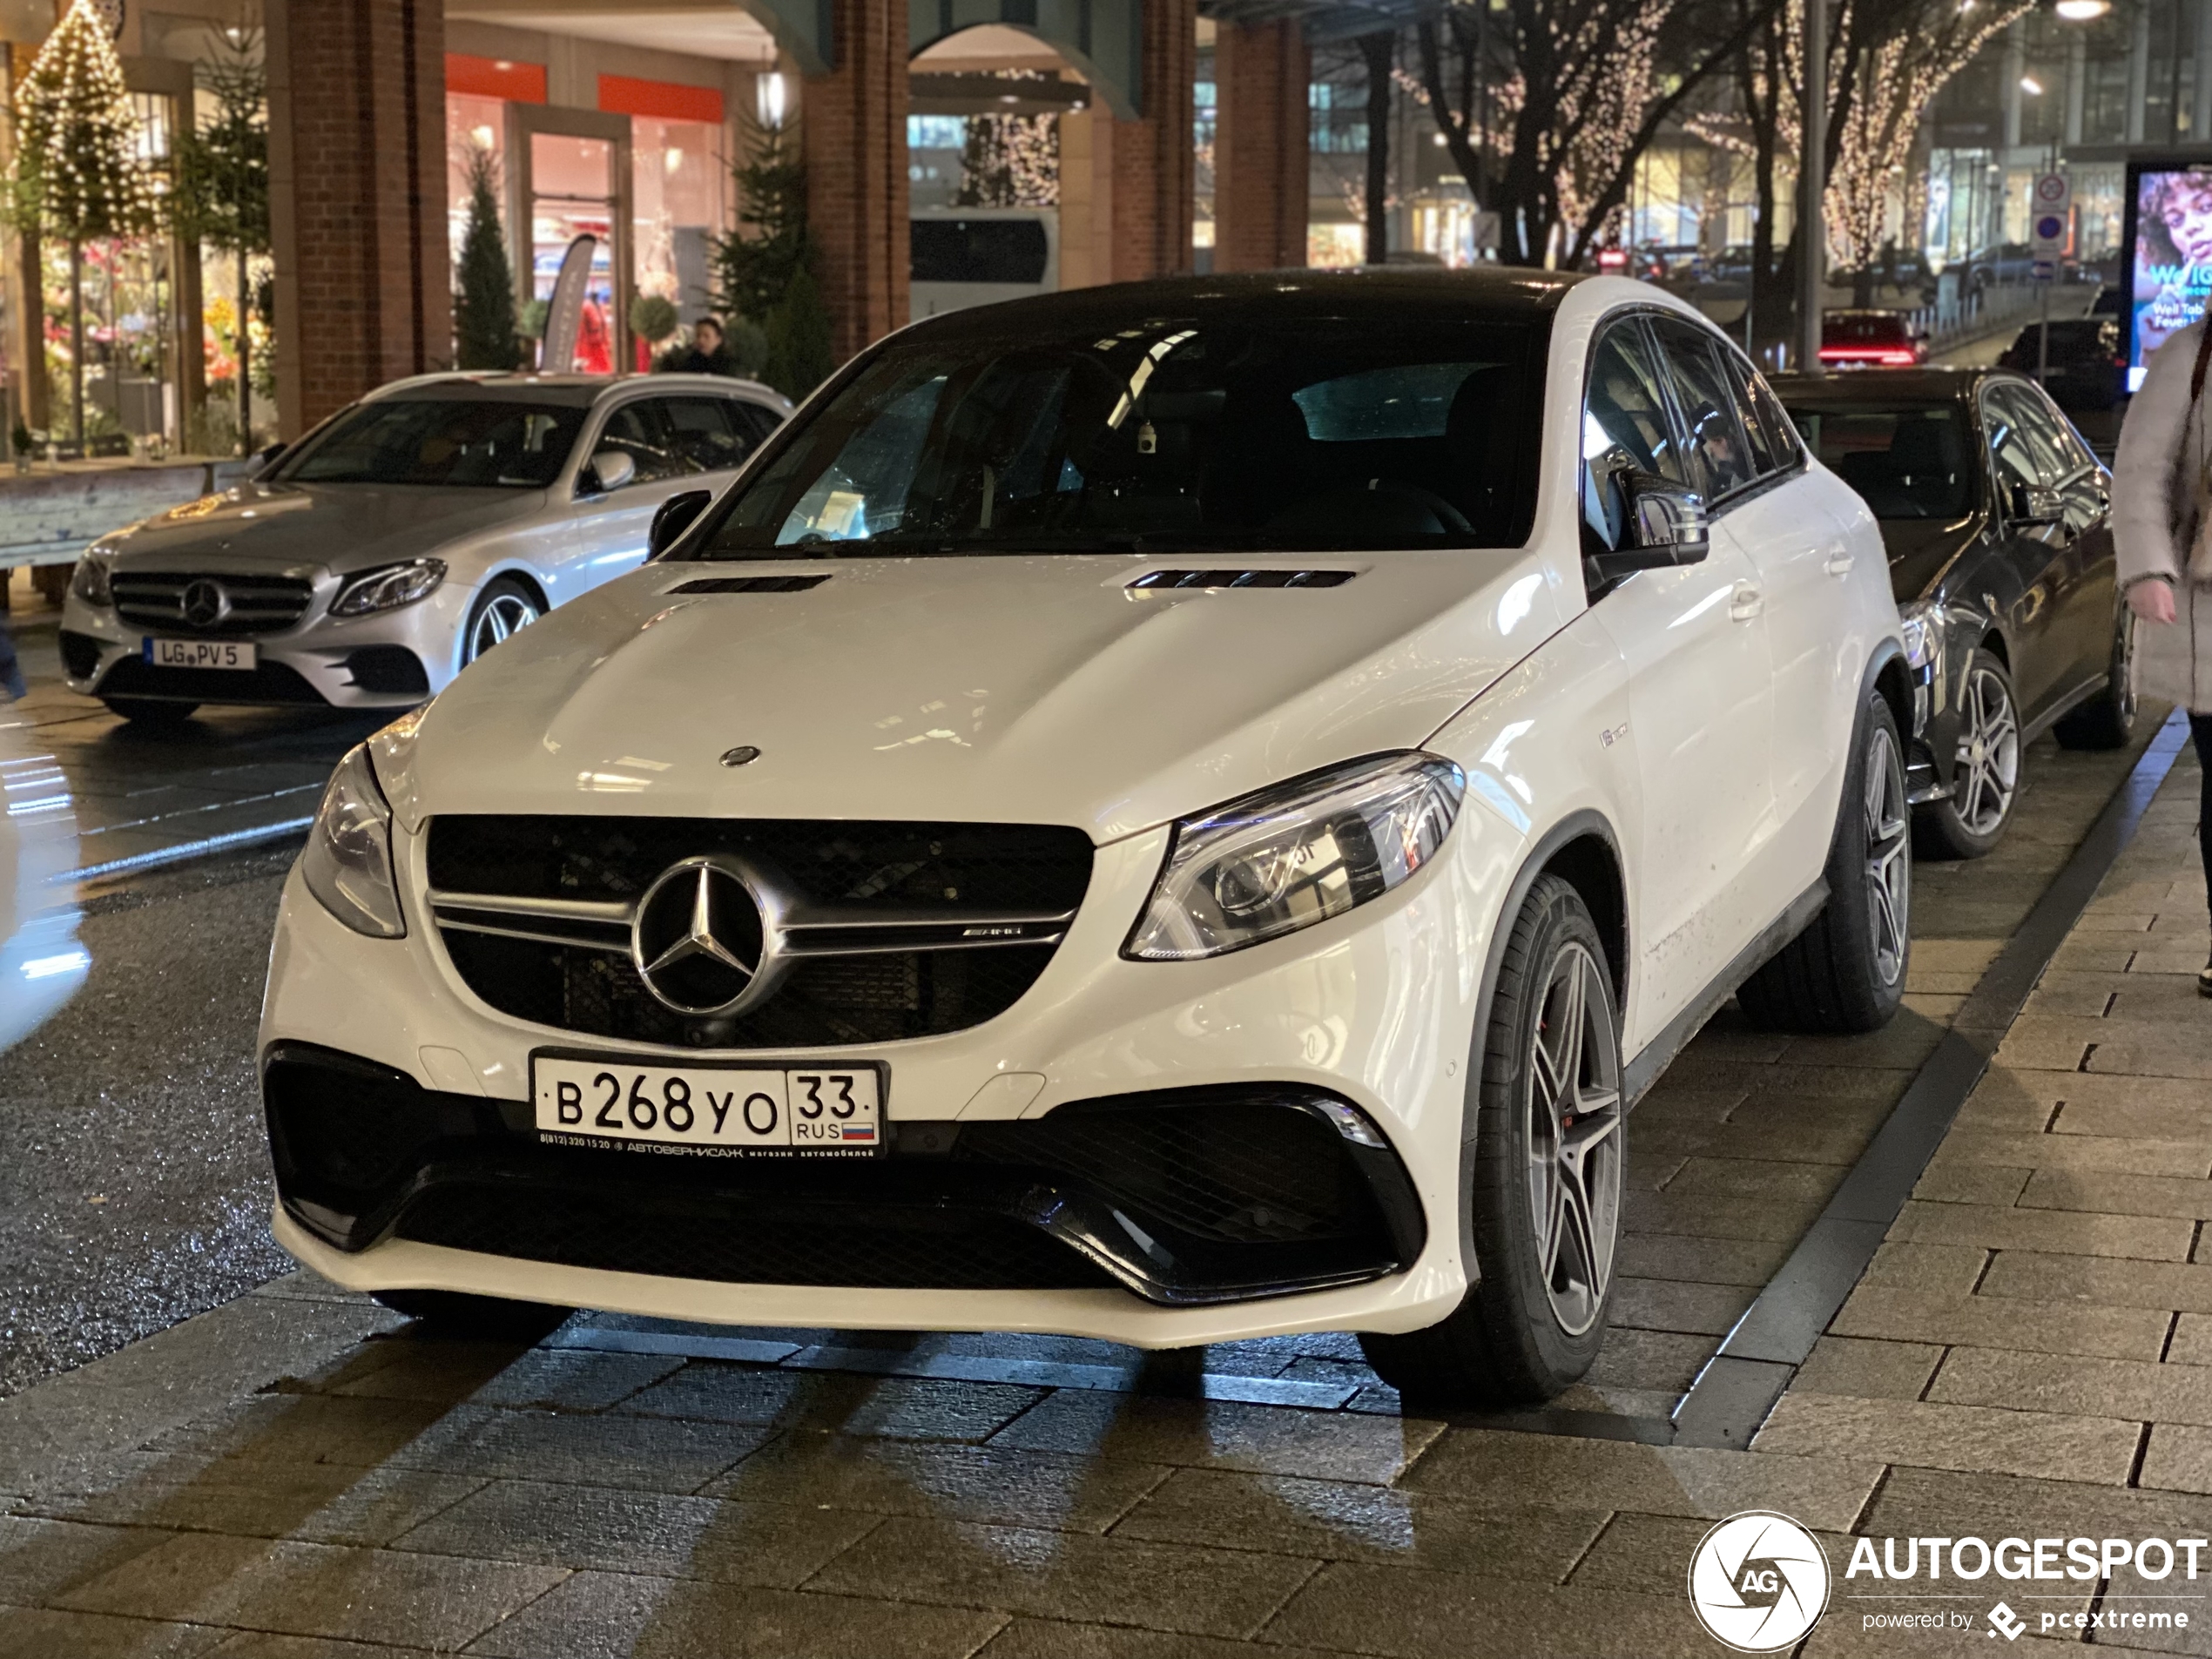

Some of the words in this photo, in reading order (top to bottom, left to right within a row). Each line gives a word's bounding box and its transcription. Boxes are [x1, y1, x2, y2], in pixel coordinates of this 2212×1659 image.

[226, 646, 238, 665] 5
[798, 1076, 856, 1119] 33
[797, 1123, 840, 1140] RUS
[540, 1133, 568, 1145] 8(812)
[569, 1136, 585, 1147] 320
[587, 1139, 597, 1148] 15
[599, 1140, 610, 1150] 20
